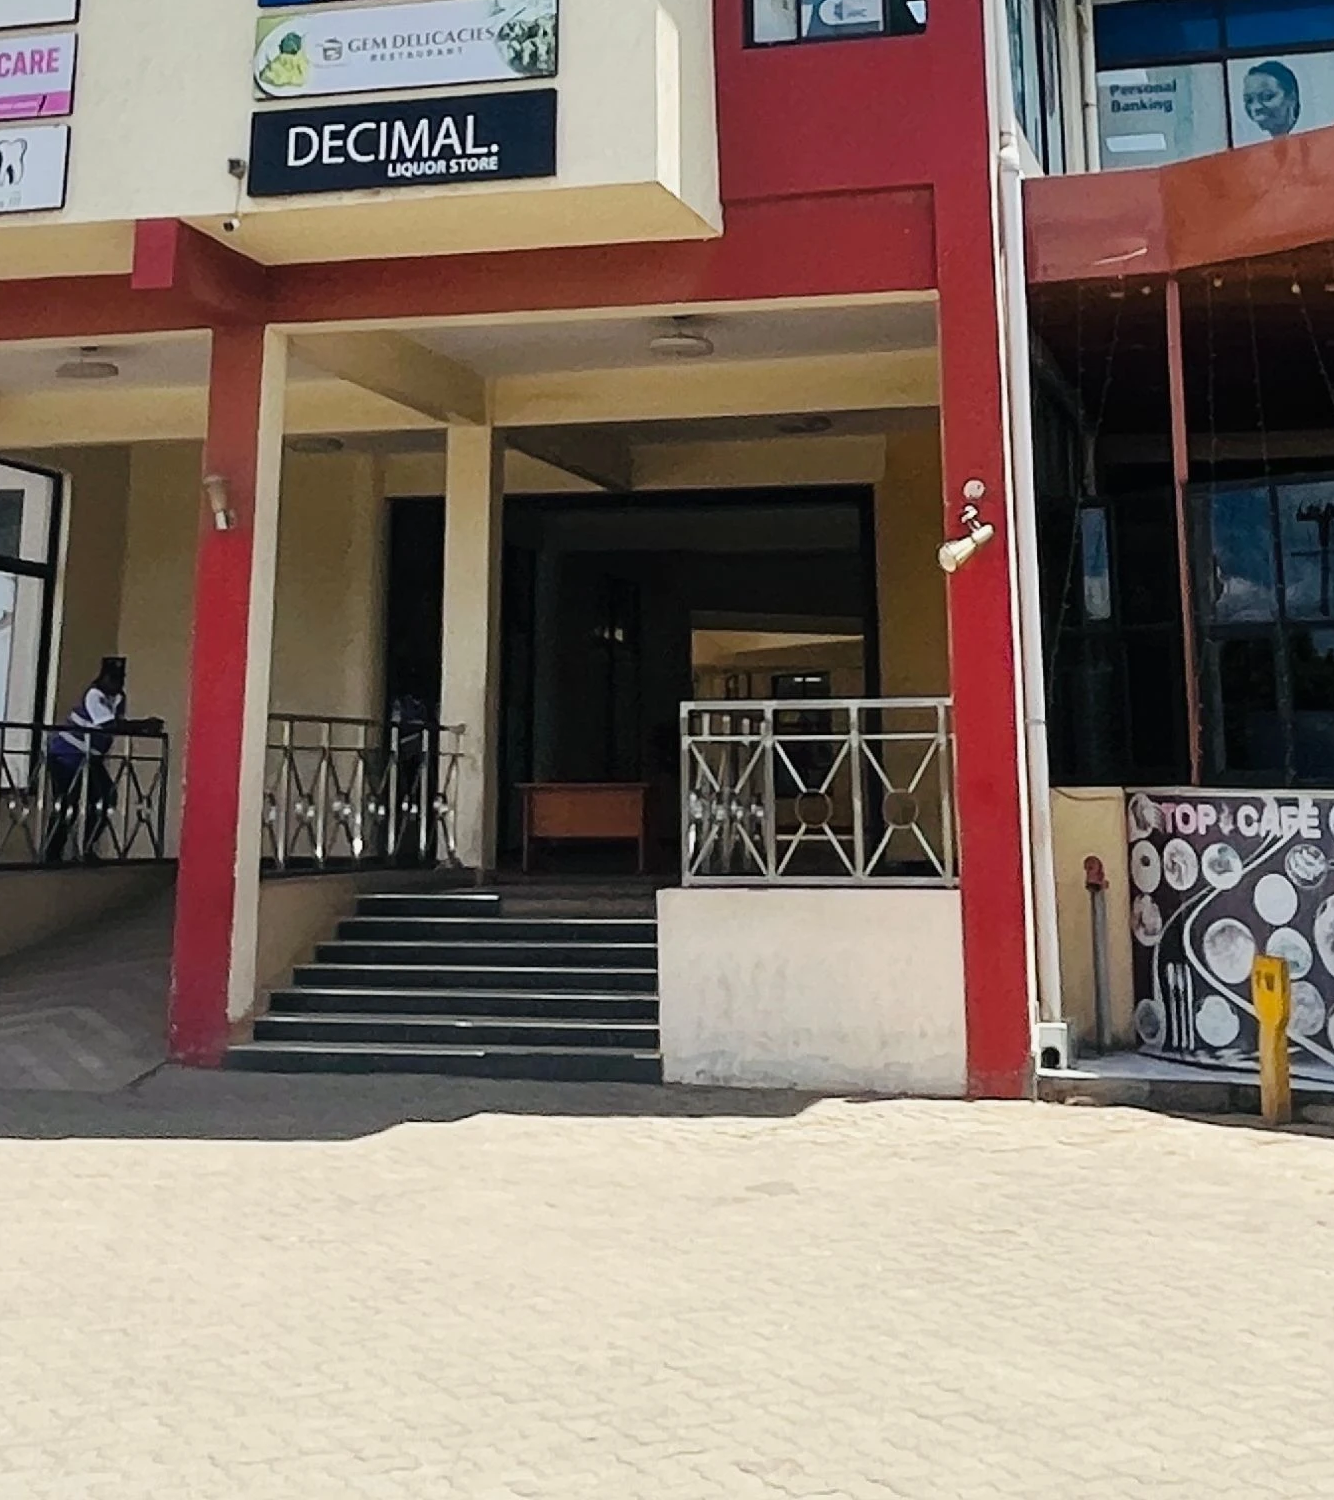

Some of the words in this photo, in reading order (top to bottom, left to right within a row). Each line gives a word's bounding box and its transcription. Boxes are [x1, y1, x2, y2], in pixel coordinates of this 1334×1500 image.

[348, 36, 387, 53] GEM
[393, 26, 496, 48] DELICACIES
[1110, 79, 1176, 97] Personal
[1111, 98, 1172, 113] Banking
[387, 159, 447, 178] LIQUOR
[449, 155, 499, 174] STORE
[1162, 802, 1217, 836] TOP
[1236, 801, 1322, 839] CAFE
